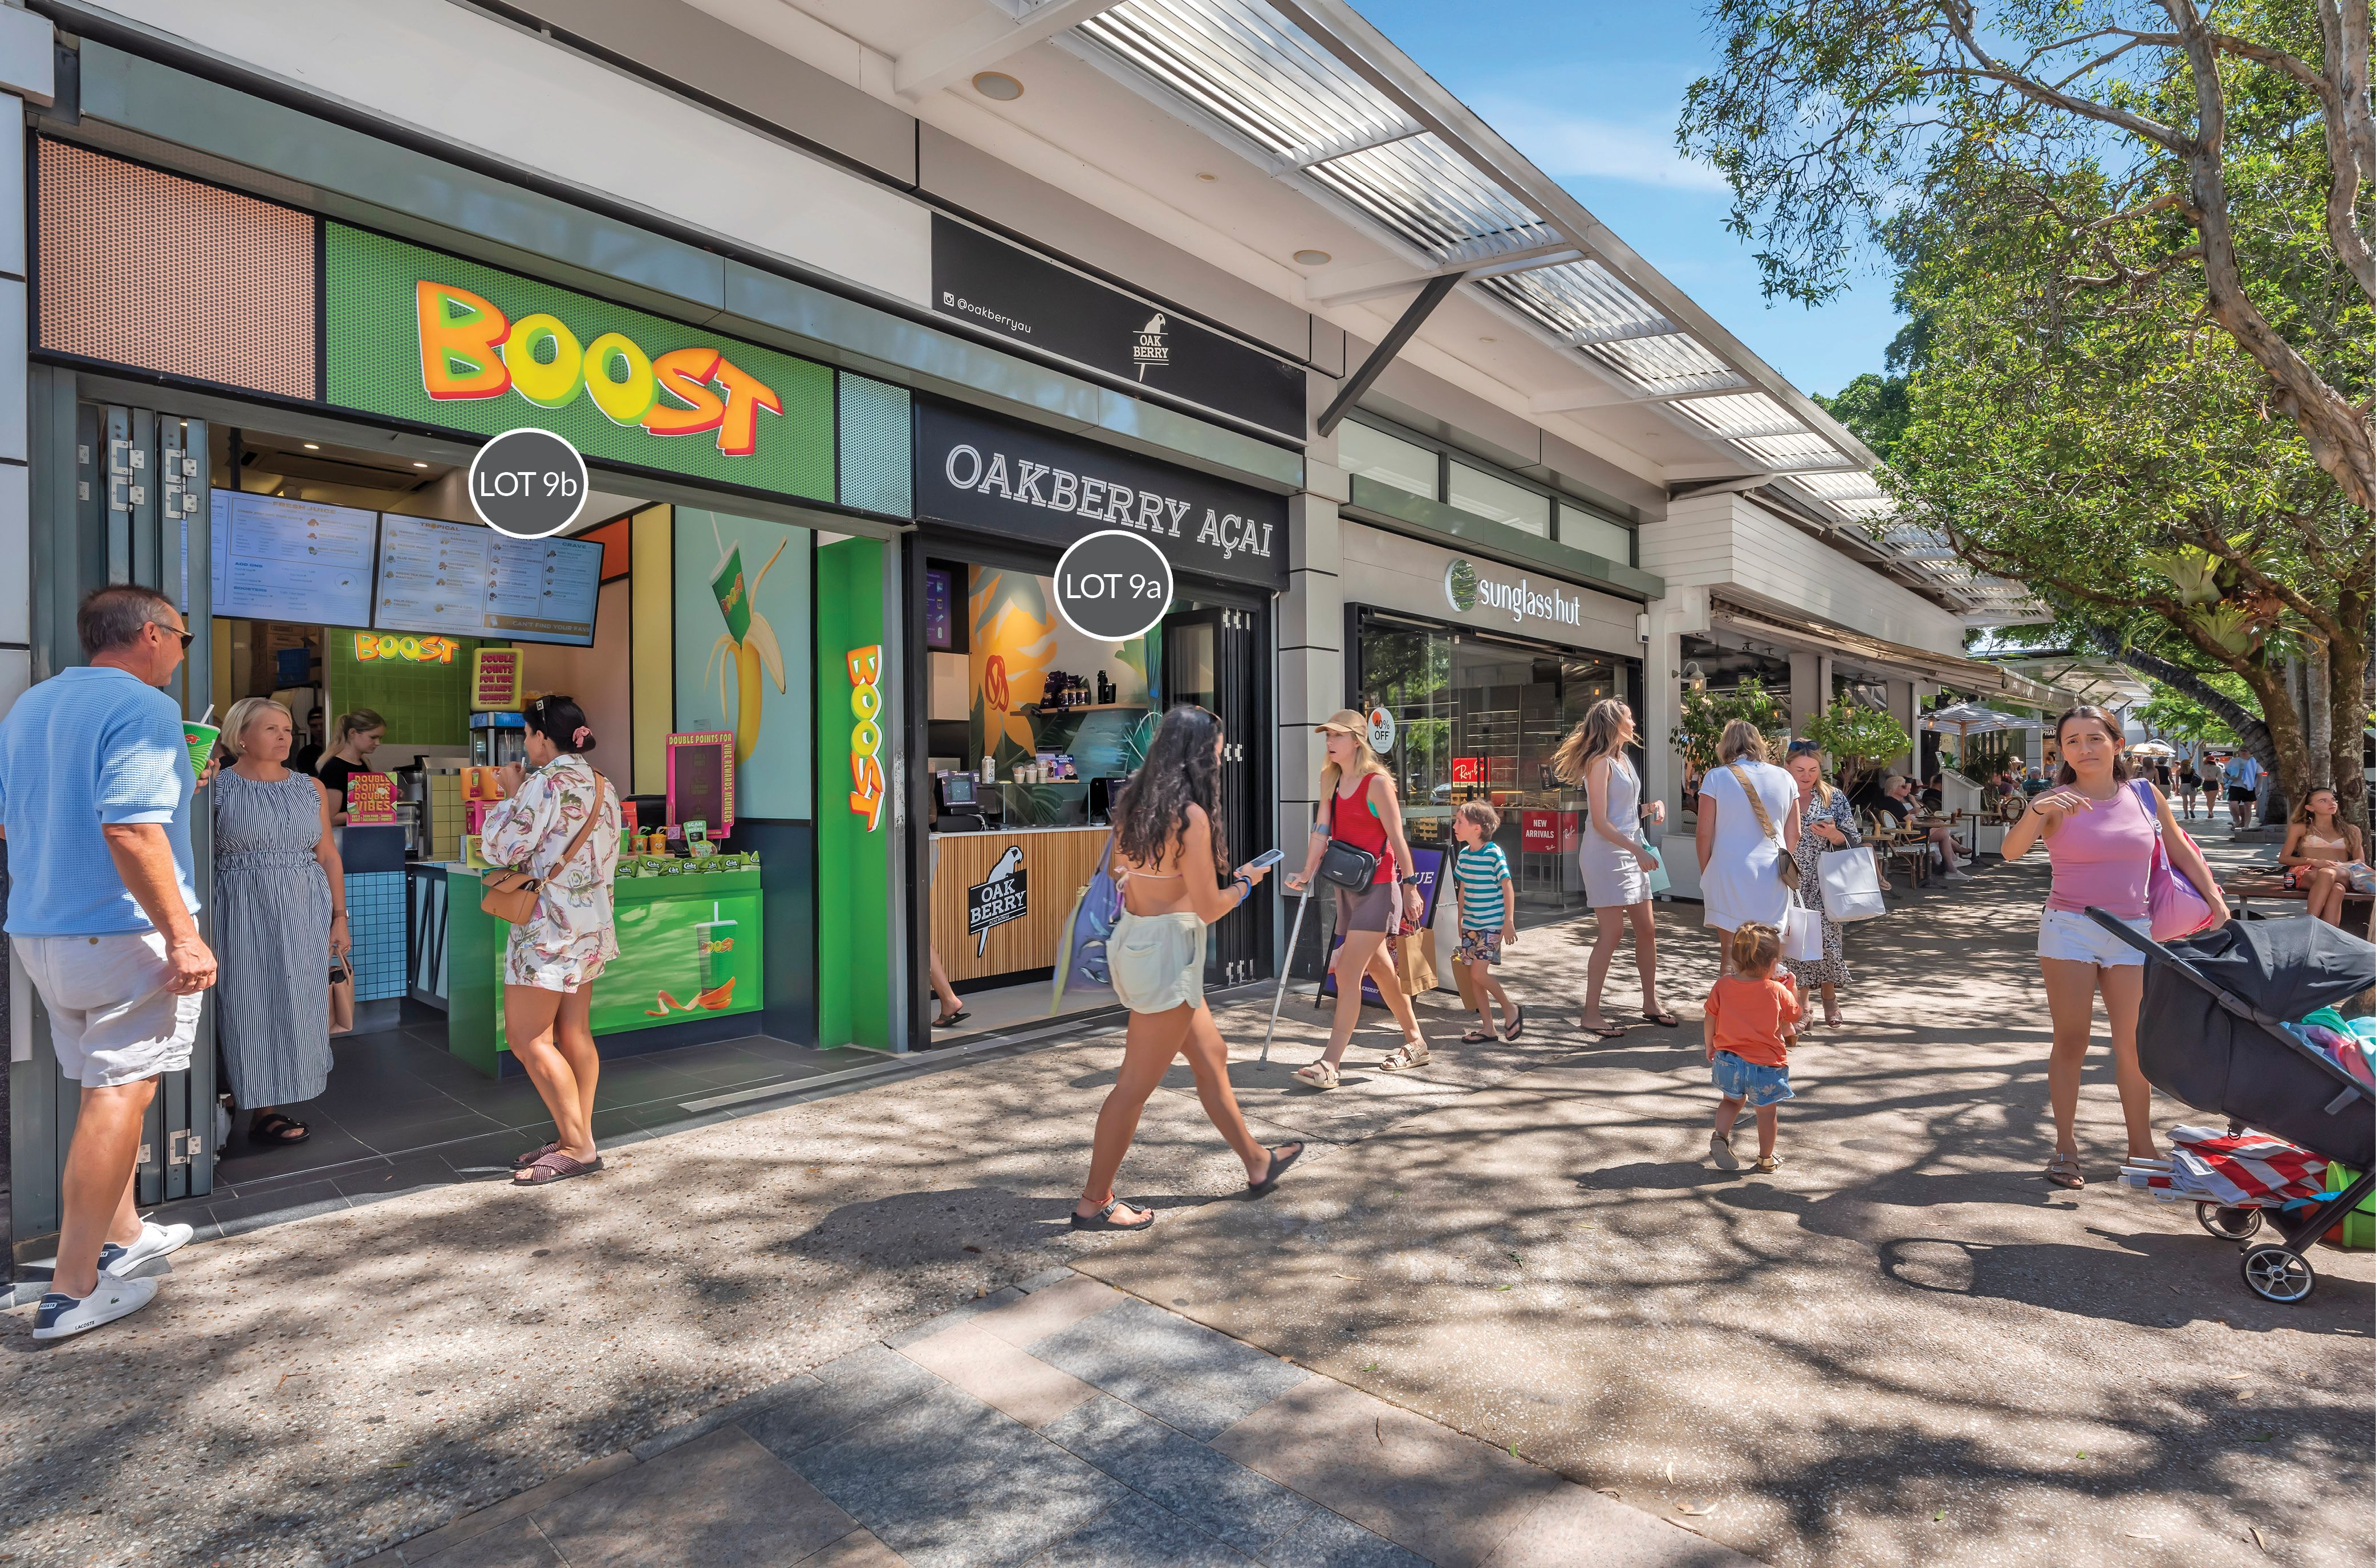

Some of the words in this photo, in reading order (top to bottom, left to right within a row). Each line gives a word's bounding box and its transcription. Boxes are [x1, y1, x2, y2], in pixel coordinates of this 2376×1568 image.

[957, 298, 1031, 334] @oakberryau
[1140, 335, 1161, 347] OAK
[1134, 347, 1169, 359] BERRY
[417, 279, 783, 456] BOOST
[273, 501, 305, 510] FRESH
[945, 444, 1191, 538] OAKBERRY
[1197, 509, 1273, 559] AÇAI
[720, 571, 743, 616] BOOST
[1479, 579, 1552, 622] sunglass
[1554, 588, 1581, 626] hut
[355, 633, 462, 664] BOOST
[481, 653, 515, 663] DOUBLE
[481, 664, 513, 673] POINTS
[480, 675, 495, 683] FOR
[496, 675, 513, 683] VIBE
[1375, 720, 1390, 730] 40%
[669, 736, 694, 745] DOUBLE
[695, 734, 718, 744] POINTS
[720, 733, 732, 742] FOR
[846, 644, 886, 832] BOOST
[723, 743, 732, 758] VIBE
[723, 759, 732, 790] REWARDS
[354, 783, 391, 793] POINTS
[354, 801, 391, 812] VIBES
[981, 878, 1015, 903] OAK
[970, 891, 1026, 924] BERRY
[699, 937, 734, 955] BOOST
[75, 1320, 95, 1330] LACOSTE
